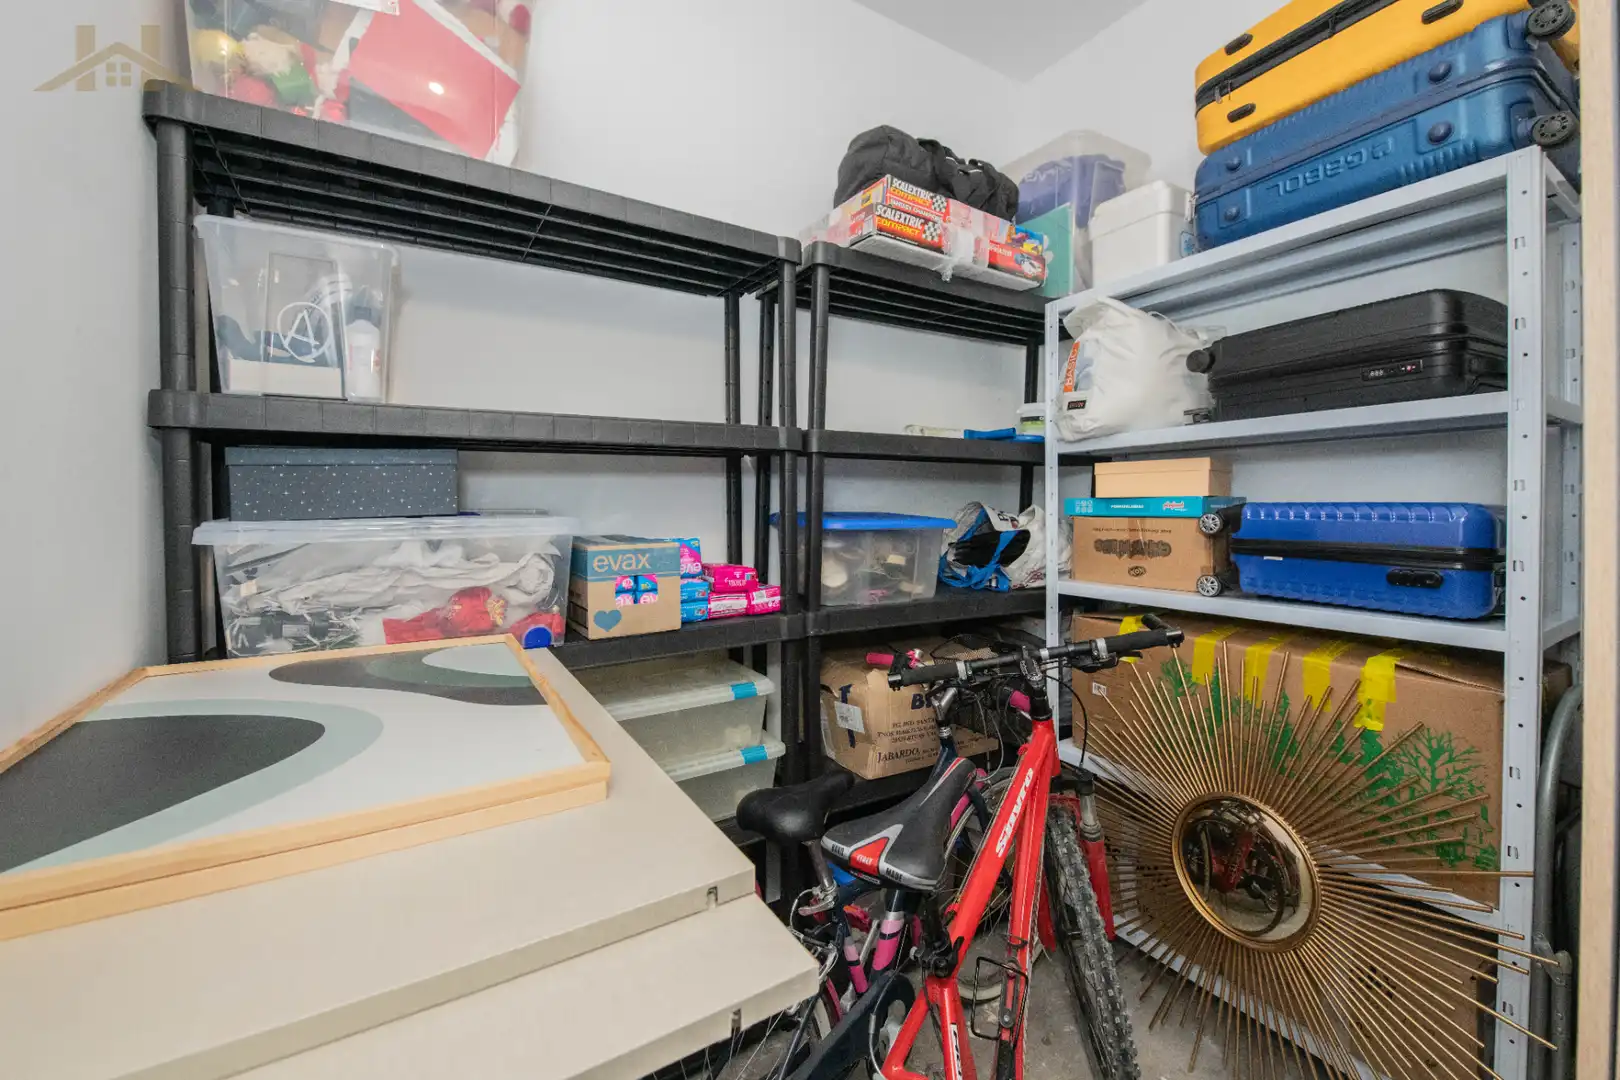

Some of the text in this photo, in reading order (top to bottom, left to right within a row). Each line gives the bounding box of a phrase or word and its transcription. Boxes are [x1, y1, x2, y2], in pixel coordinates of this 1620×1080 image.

[892, 178, 934, 201] SCALEXTRIC
[876, 204, 925, 229] SCALEXTRIC
[592, 552, 651, 573] evax
